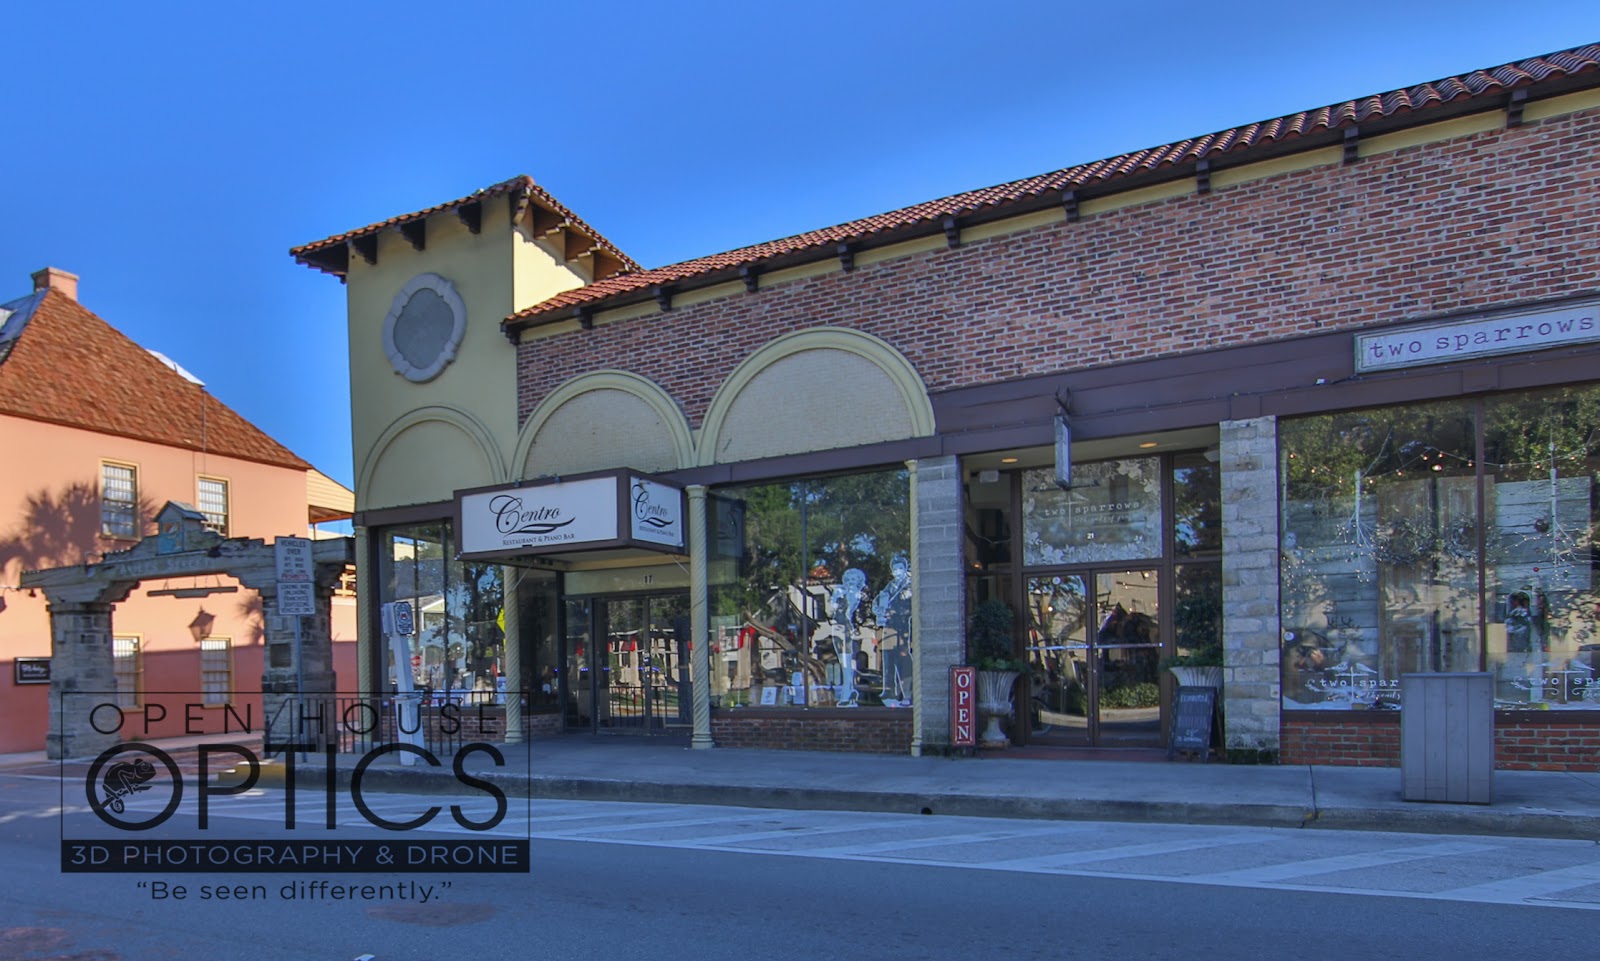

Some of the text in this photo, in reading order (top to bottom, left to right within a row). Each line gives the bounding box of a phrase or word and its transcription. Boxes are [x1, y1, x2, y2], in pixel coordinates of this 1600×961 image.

[1370, 316, 1594, 358] two sparrows
[632, 484, 668, 520] Centro
[1044, 501, 1140, 516] two sparrows
[489, 494, 561, 534] Centro
[502, 537, 537, 546] RESTAURANT
[544, 534, 562, 542] PIANO
[1086, 532, 1095, 540] 21
[643, 574, 653, 584] 17
[1319, 678, 1399, 689] two spar
[1528, 677, 1560, 685] two
[957, 673, 970, 740] OPEN
